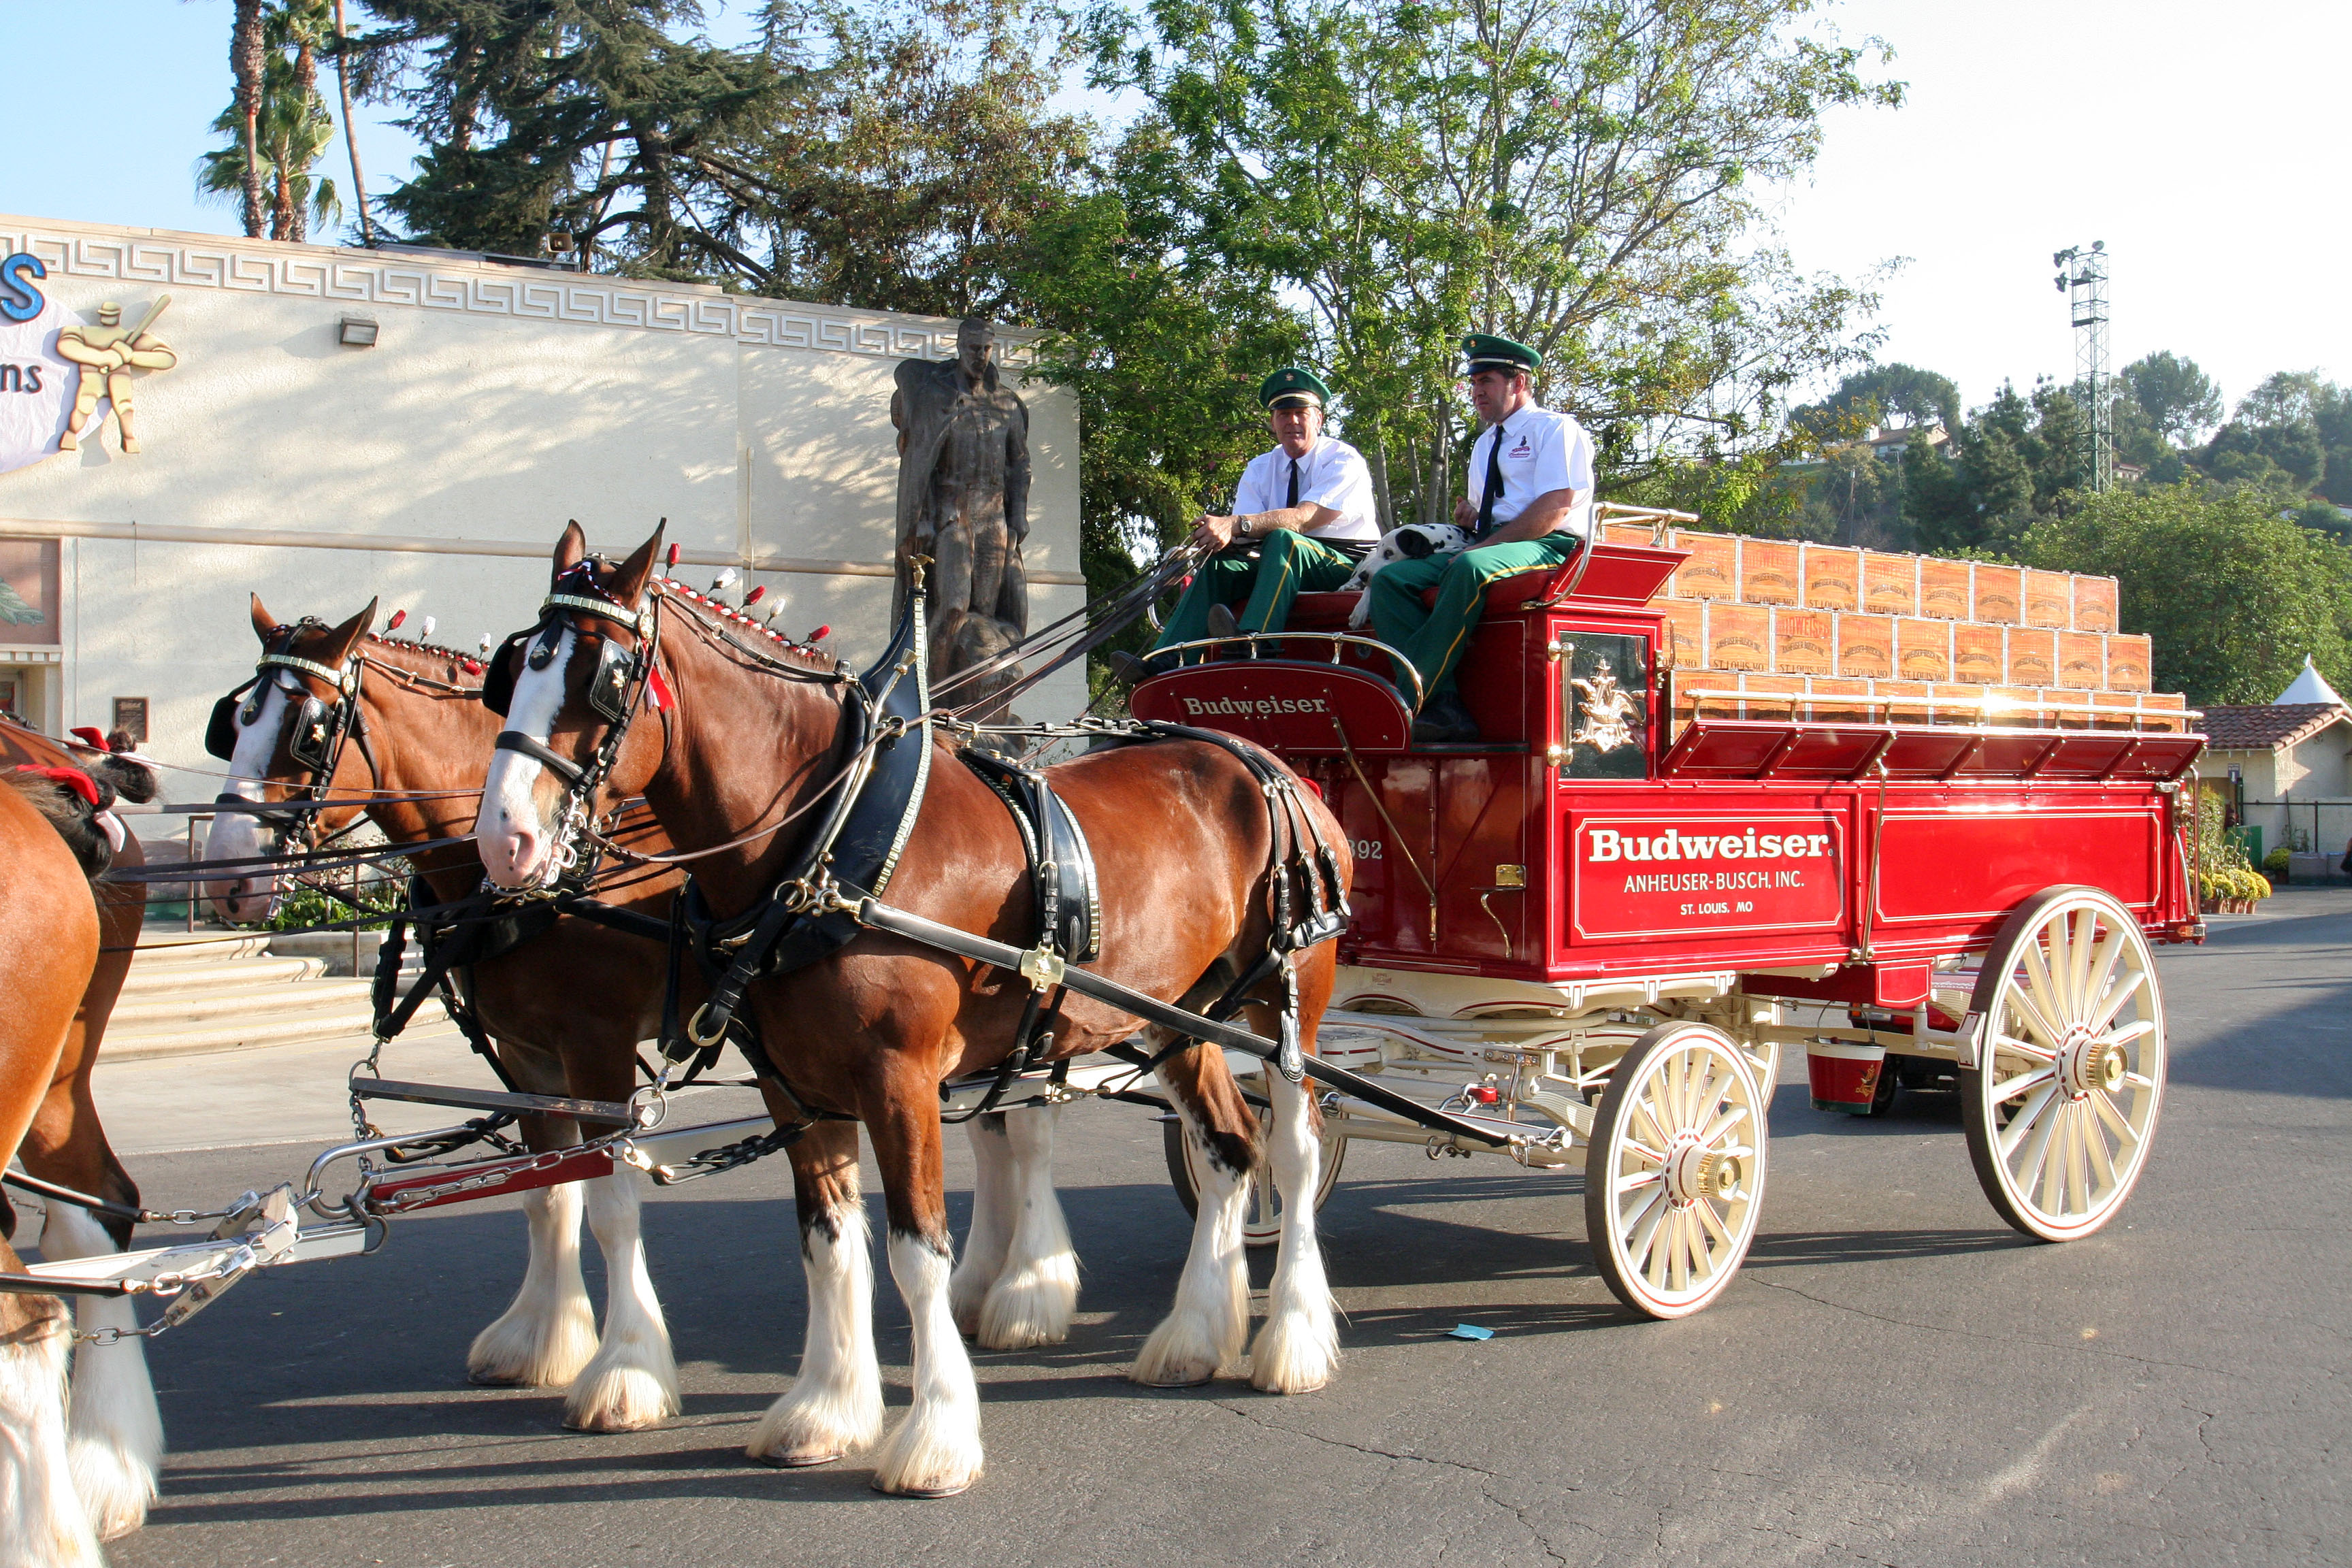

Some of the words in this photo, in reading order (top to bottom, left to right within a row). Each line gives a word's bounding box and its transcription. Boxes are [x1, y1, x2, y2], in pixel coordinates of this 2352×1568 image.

[1183, 696, 1326, 715] Budweiser
[1588, 827, 1829, 862] Budweiser
[1624, 872, 1771, 893] ANHEUSER-BUSCH,
[1776, 870, 1805, 887] INC.
[1680, 904, 1695, 915] ST.
[1736, 901, 1753, 913] MO
